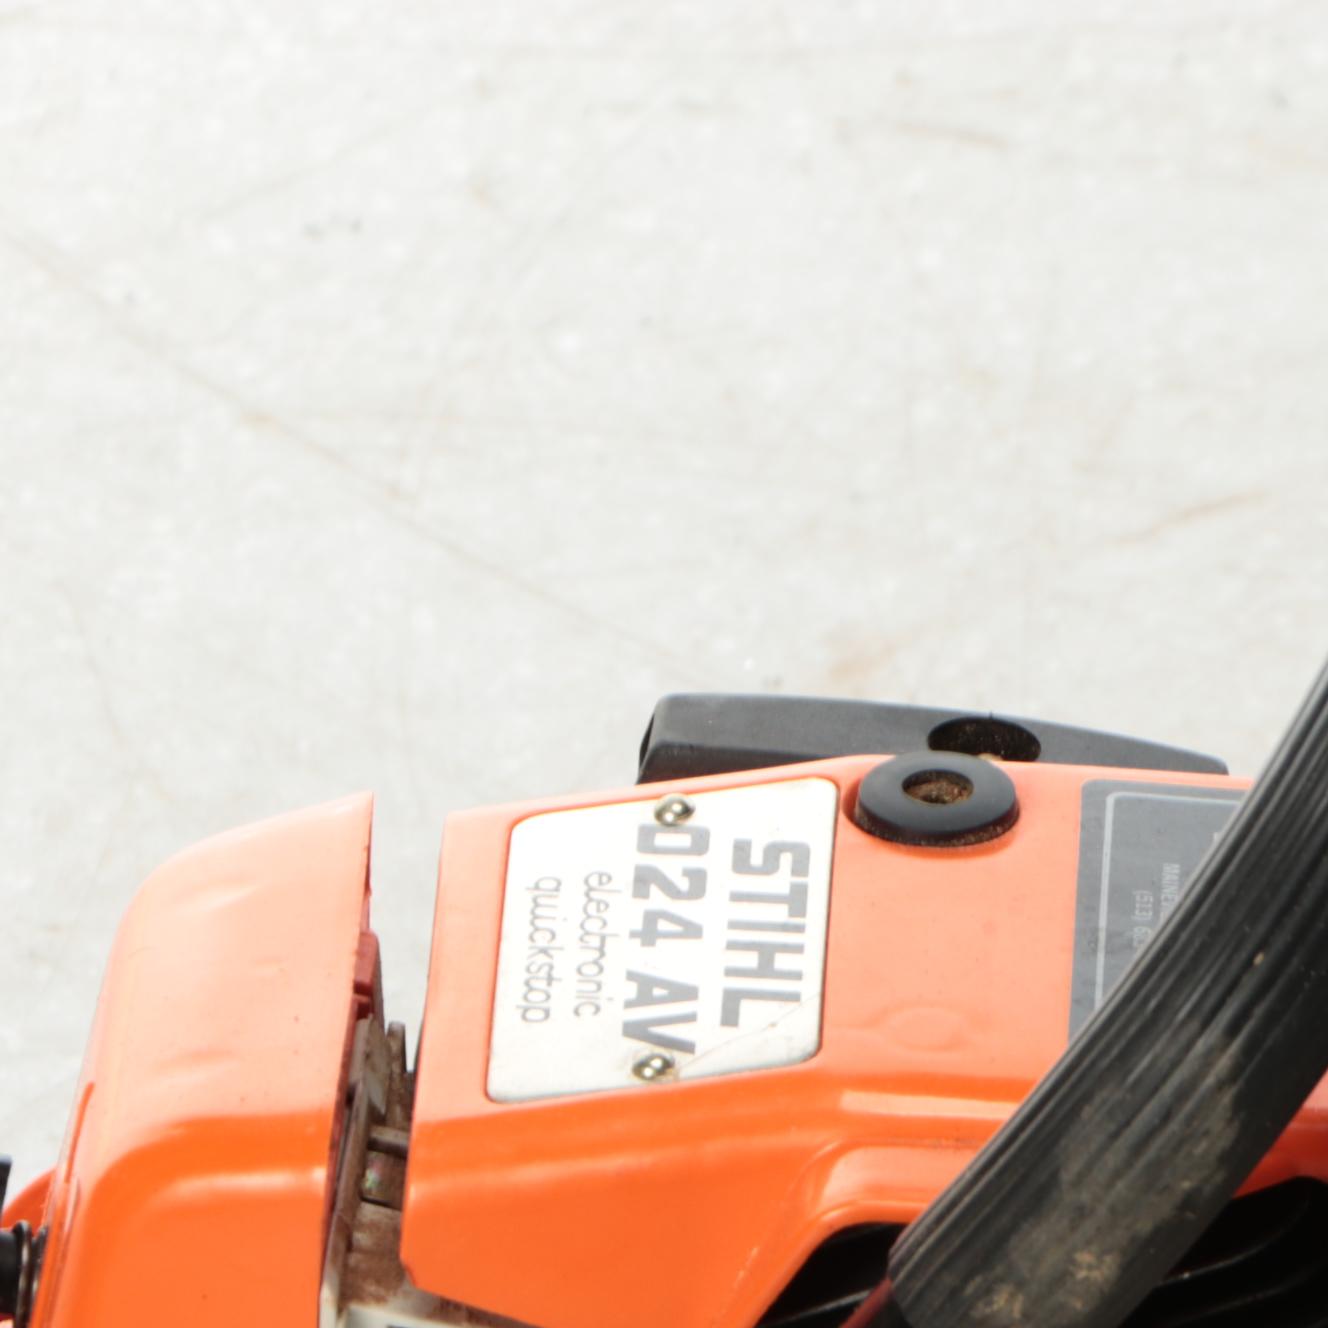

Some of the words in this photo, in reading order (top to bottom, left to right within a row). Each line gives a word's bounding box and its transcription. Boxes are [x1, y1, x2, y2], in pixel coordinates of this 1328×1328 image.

[516, 876, 567, 1023] quickstop
[573, 871, 622, 1018] electronic
[629, 823, 711, 948] 024
[720, 838, 811, 1028] STIHL
[621, 968, 700, 1055] AV
